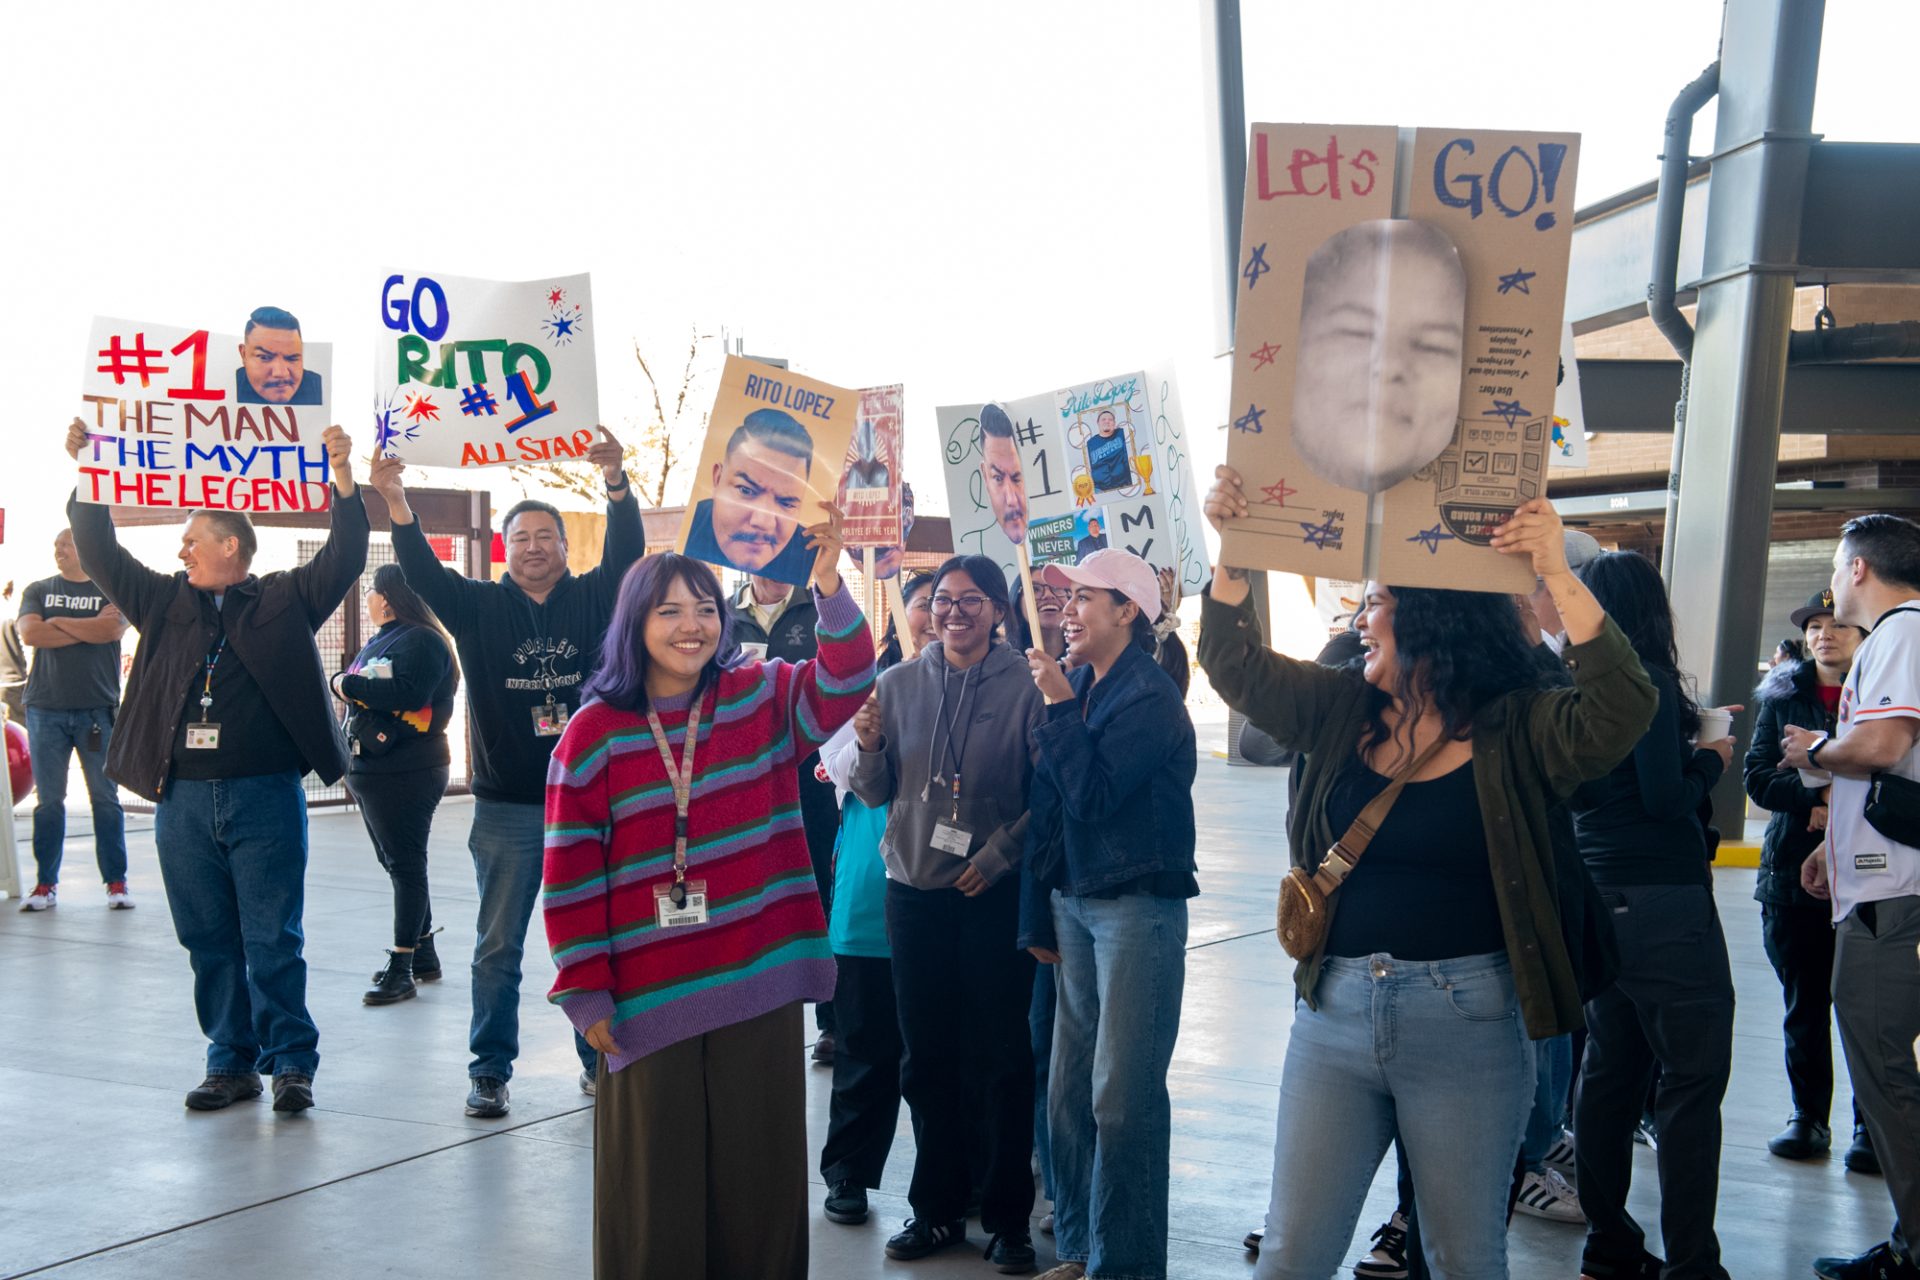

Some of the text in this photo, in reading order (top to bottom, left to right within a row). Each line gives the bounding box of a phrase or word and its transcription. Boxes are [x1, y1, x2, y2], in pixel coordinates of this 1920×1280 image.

[1256, 133, 1379, 200] Lets
[1434, 138, 1567, 231] GO!
[381, 275, 449, 341] GO
[97, 330, 225, 400] #1
[398, 334, 551, 394] RITO
[1483, 368, 1496, 376] Fair
[1489, 347, 1522, 356] Classroom
[1479, 385, 1513, 396] Use for:
[1496, 369, 1520, 377] Science
[459, 370, 558, 434] #1
[744, 374, 782, 408] RITO
[784, 385, 835, 420] LOPEZ
[83, 395, 300, 442] THE MAN
[85, 432, 329, 483] THE MYTH
[461, 429, 594, 466] ALL STAR
[79, 467, 330, 513] THE LEGEND
[1029, 518, 1073, 539] WINNERS
[1450, 511, 1481, 522] BOARD
[1037, 540, 1071, 553] NEVER
[45, 594, 102, 611] DETROIT
[512, 637, 579, 664] HURLEY
